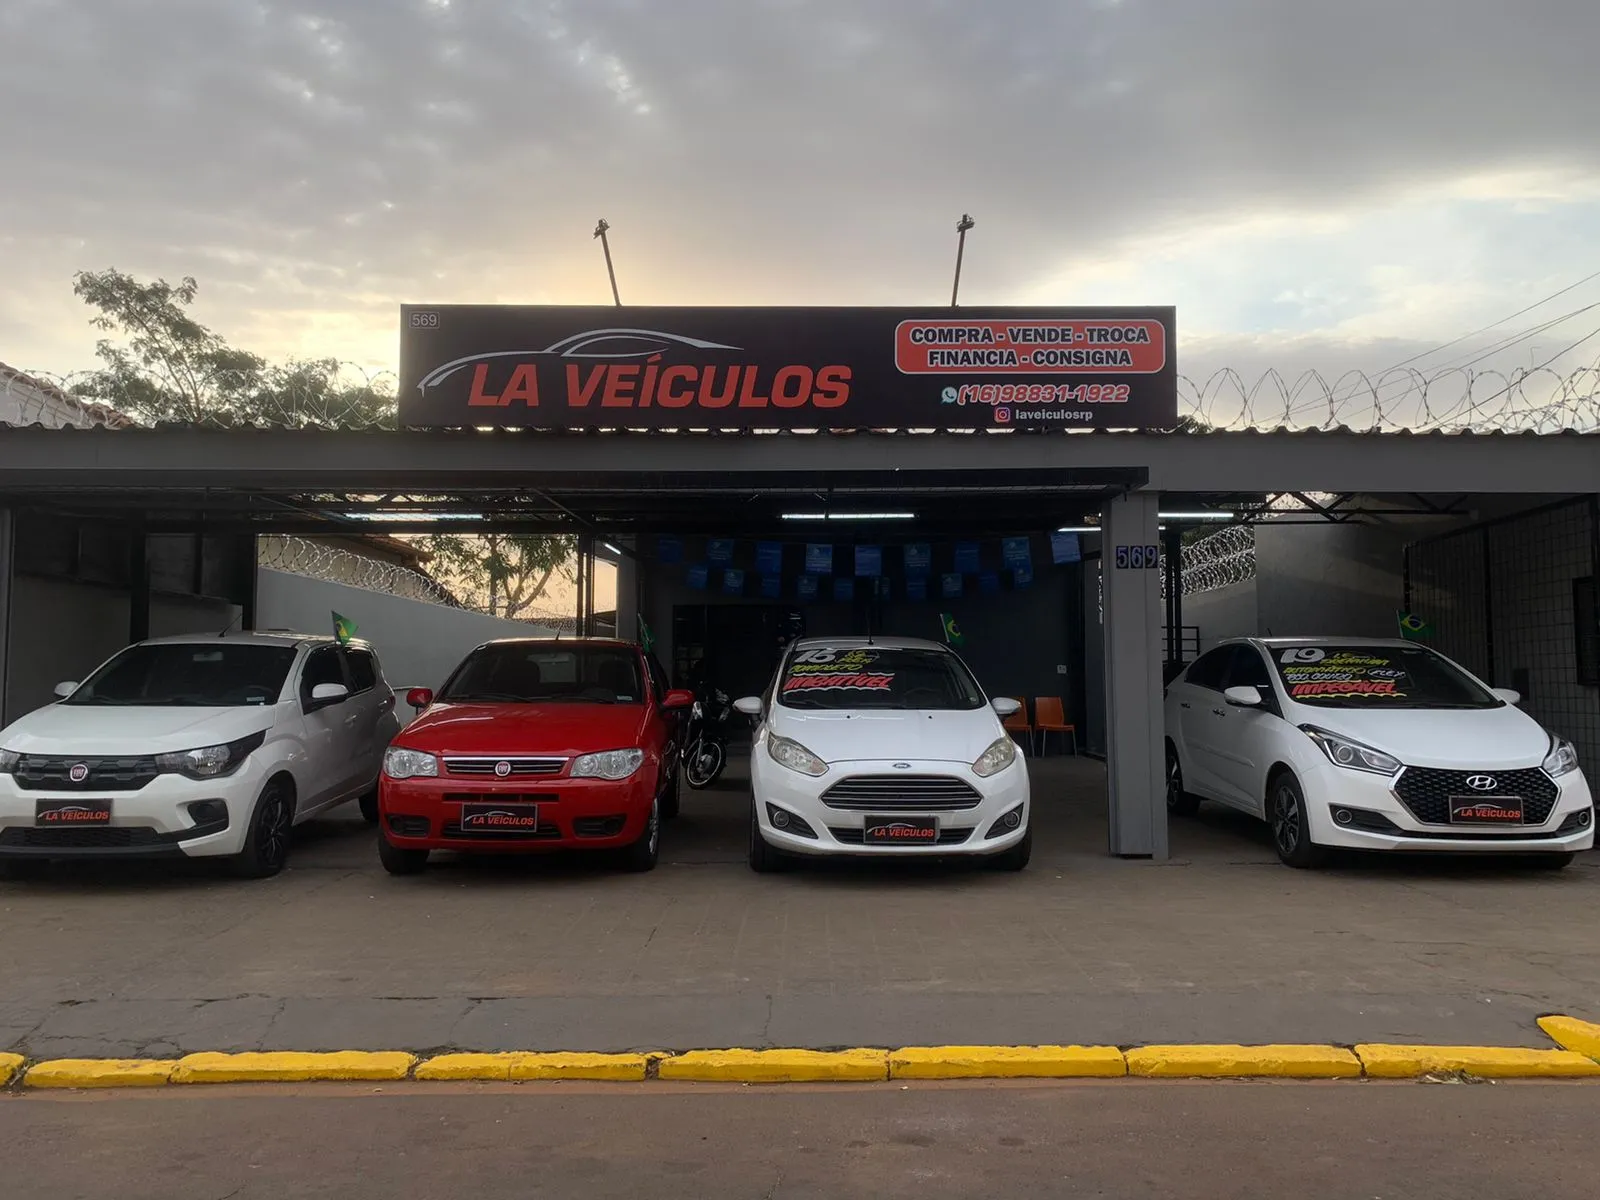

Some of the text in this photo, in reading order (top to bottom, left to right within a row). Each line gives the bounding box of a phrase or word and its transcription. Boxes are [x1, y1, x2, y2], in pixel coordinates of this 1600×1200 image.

[412, 313, 438, 327] 569
[911, 327, 994, 345] COMPRA
[1008, 326, 1072, 344] VENDE
[1086, 325, 1150, 344] TROCA
[928, 349, 1017, 367] FINANCIA
[1032, 350, 1132, 367] CONSIGNA
[467, 353, 852, 408] LA VEÍCULOS
[957, 384, 1130, 406] (16)98831-1922
[1015, 409, 1093, 422] laveiculosrp
[1116, 546, 1157, 568] 569
[794, 648, 838, 663] 15
[1280, 647, 1326, 663] 19
[46, 812, 58, 820] LA
[472, 816, 484, 824] LA
[874, 828, 886, 836] LA
